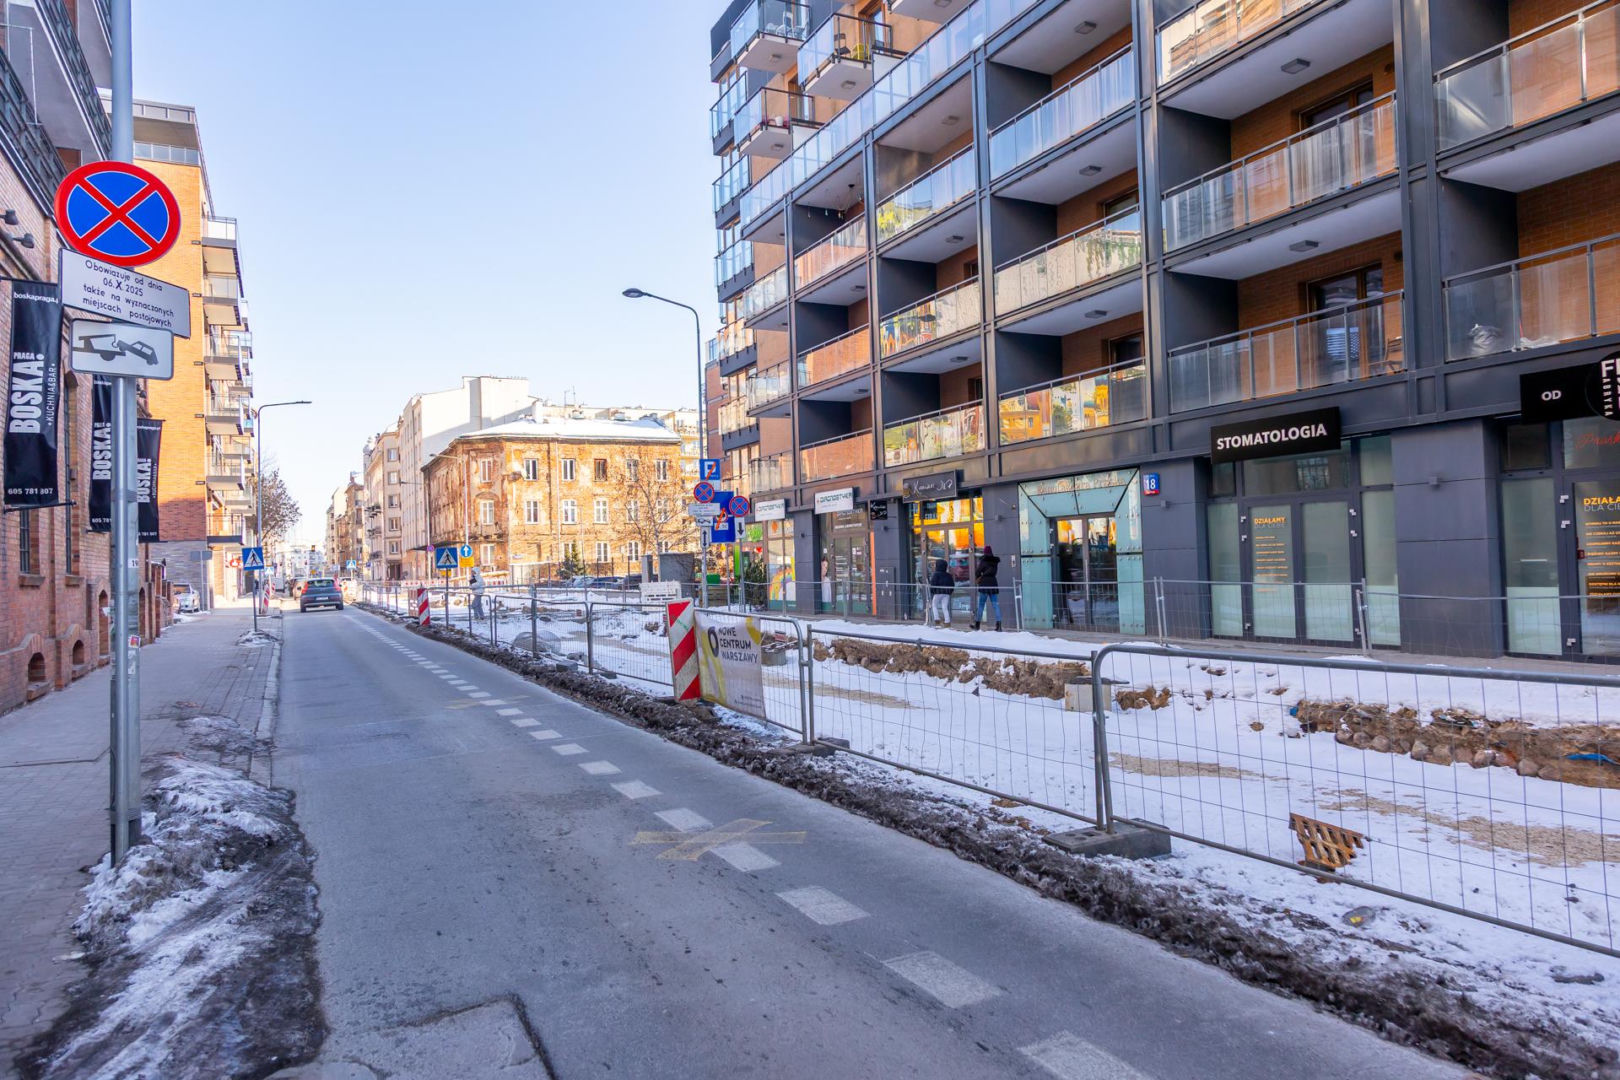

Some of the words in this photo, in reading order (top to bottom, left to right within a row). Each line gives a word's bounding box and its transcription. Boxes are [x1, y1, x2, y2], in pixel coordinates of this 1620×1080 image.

[148, 281, 162, 291] dnia
[83, 297, 121, 313] miejscach
[130, 311, 171, 327] postojowych
[125, 298, 174, 317] wyznaczonych
[14, 352, 35, 360] PRAGA
[1541, 390, 1562, 401] OD
[1216, 423, 1327, 450] STOMATOLOGIA
[1144, 478, 1156, 490] 18
[719, 627, 736, 637] NOWE
[720, 638, 752, 650] CENTRUM
[722, 651, 758, 663] WARSZAWY
